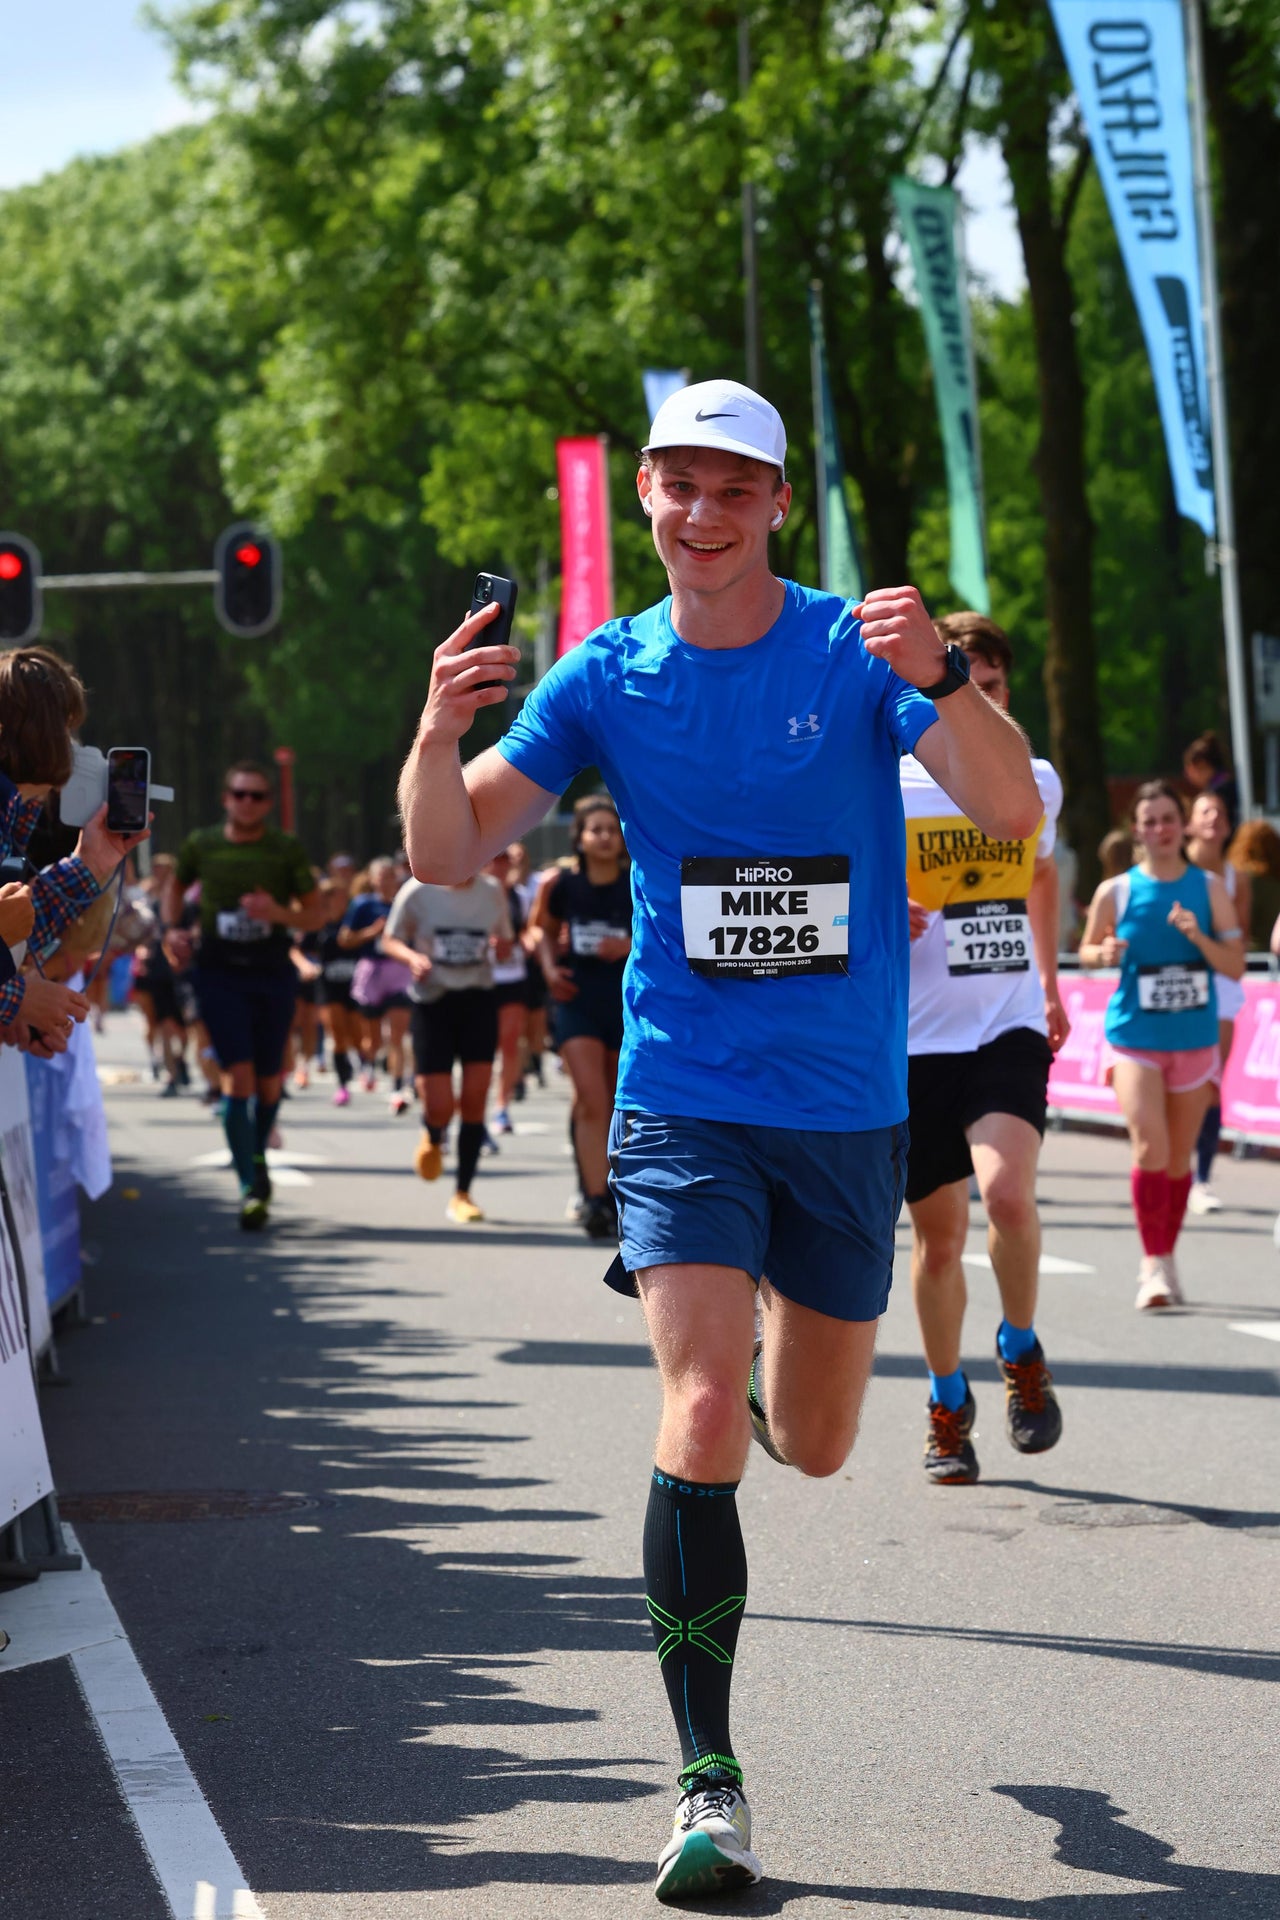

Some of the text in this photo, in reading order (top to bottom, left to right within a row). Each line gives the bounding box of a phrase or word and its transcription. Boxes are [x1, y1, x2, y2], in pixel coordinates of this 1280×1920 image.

[917, 828, 1024, 853] UTREC
[919, 846, 1025, 873] UNIVERSITY
[736, 867, 793, 882] HiPRO
[721, 890, 809, 916] MIKE
[961, 919, 1023, 936] OLIVER
[708, 924, 820, 956] 17826
[964, 939, 1026, 960] 17399
[657, 1475, 715, 1497] STOX
